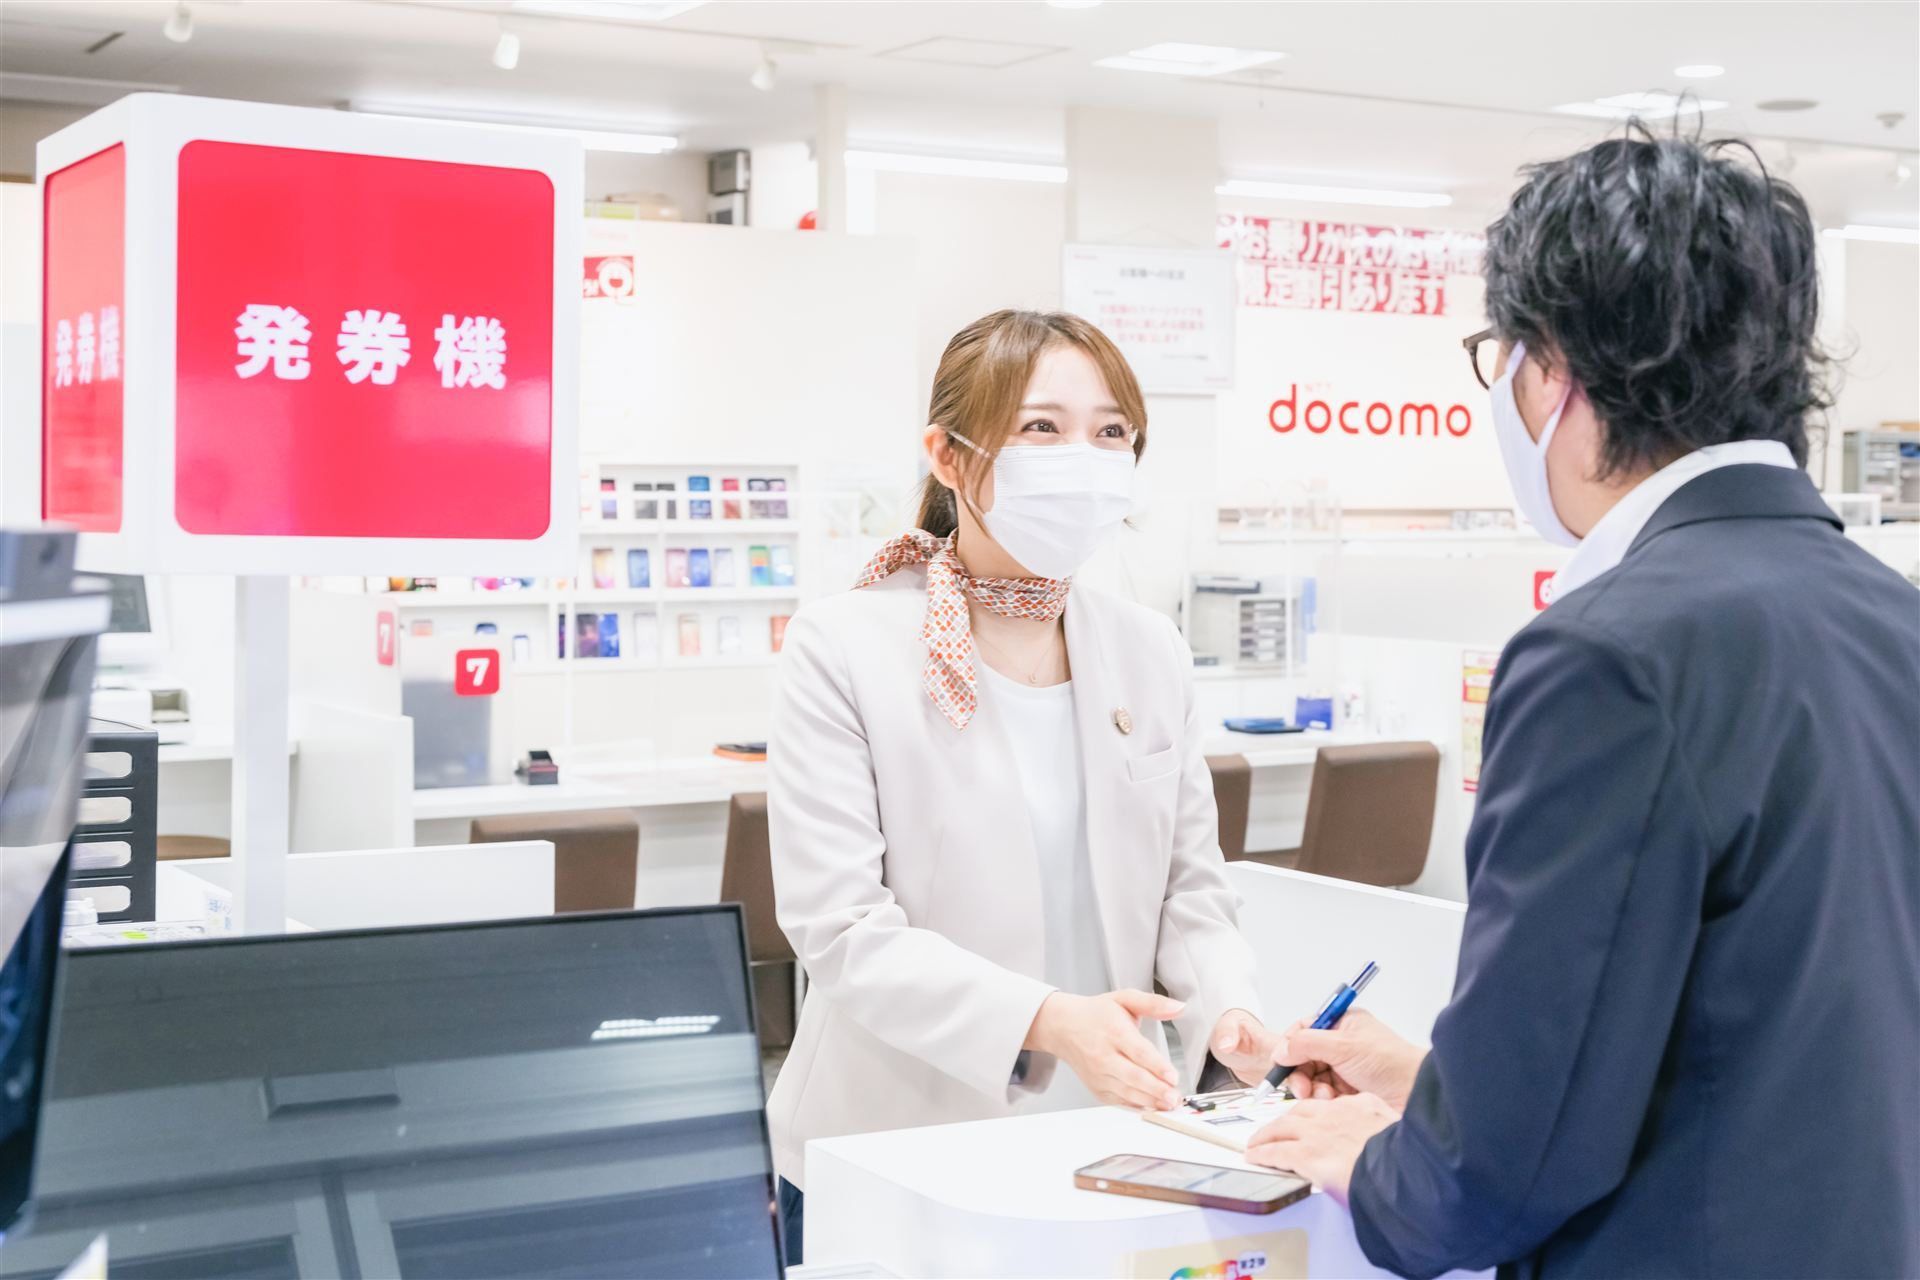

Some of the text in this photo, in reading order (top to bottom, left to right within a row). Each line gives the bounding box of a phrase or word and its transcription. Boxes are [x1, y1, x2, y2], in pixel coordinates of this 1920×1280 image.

[235, 304, 508, 390] 発券機
[1269, 384, 1471, 436] docomo
[379, 622, 392, 655] 7
[466, 657, 490, 687] 7
